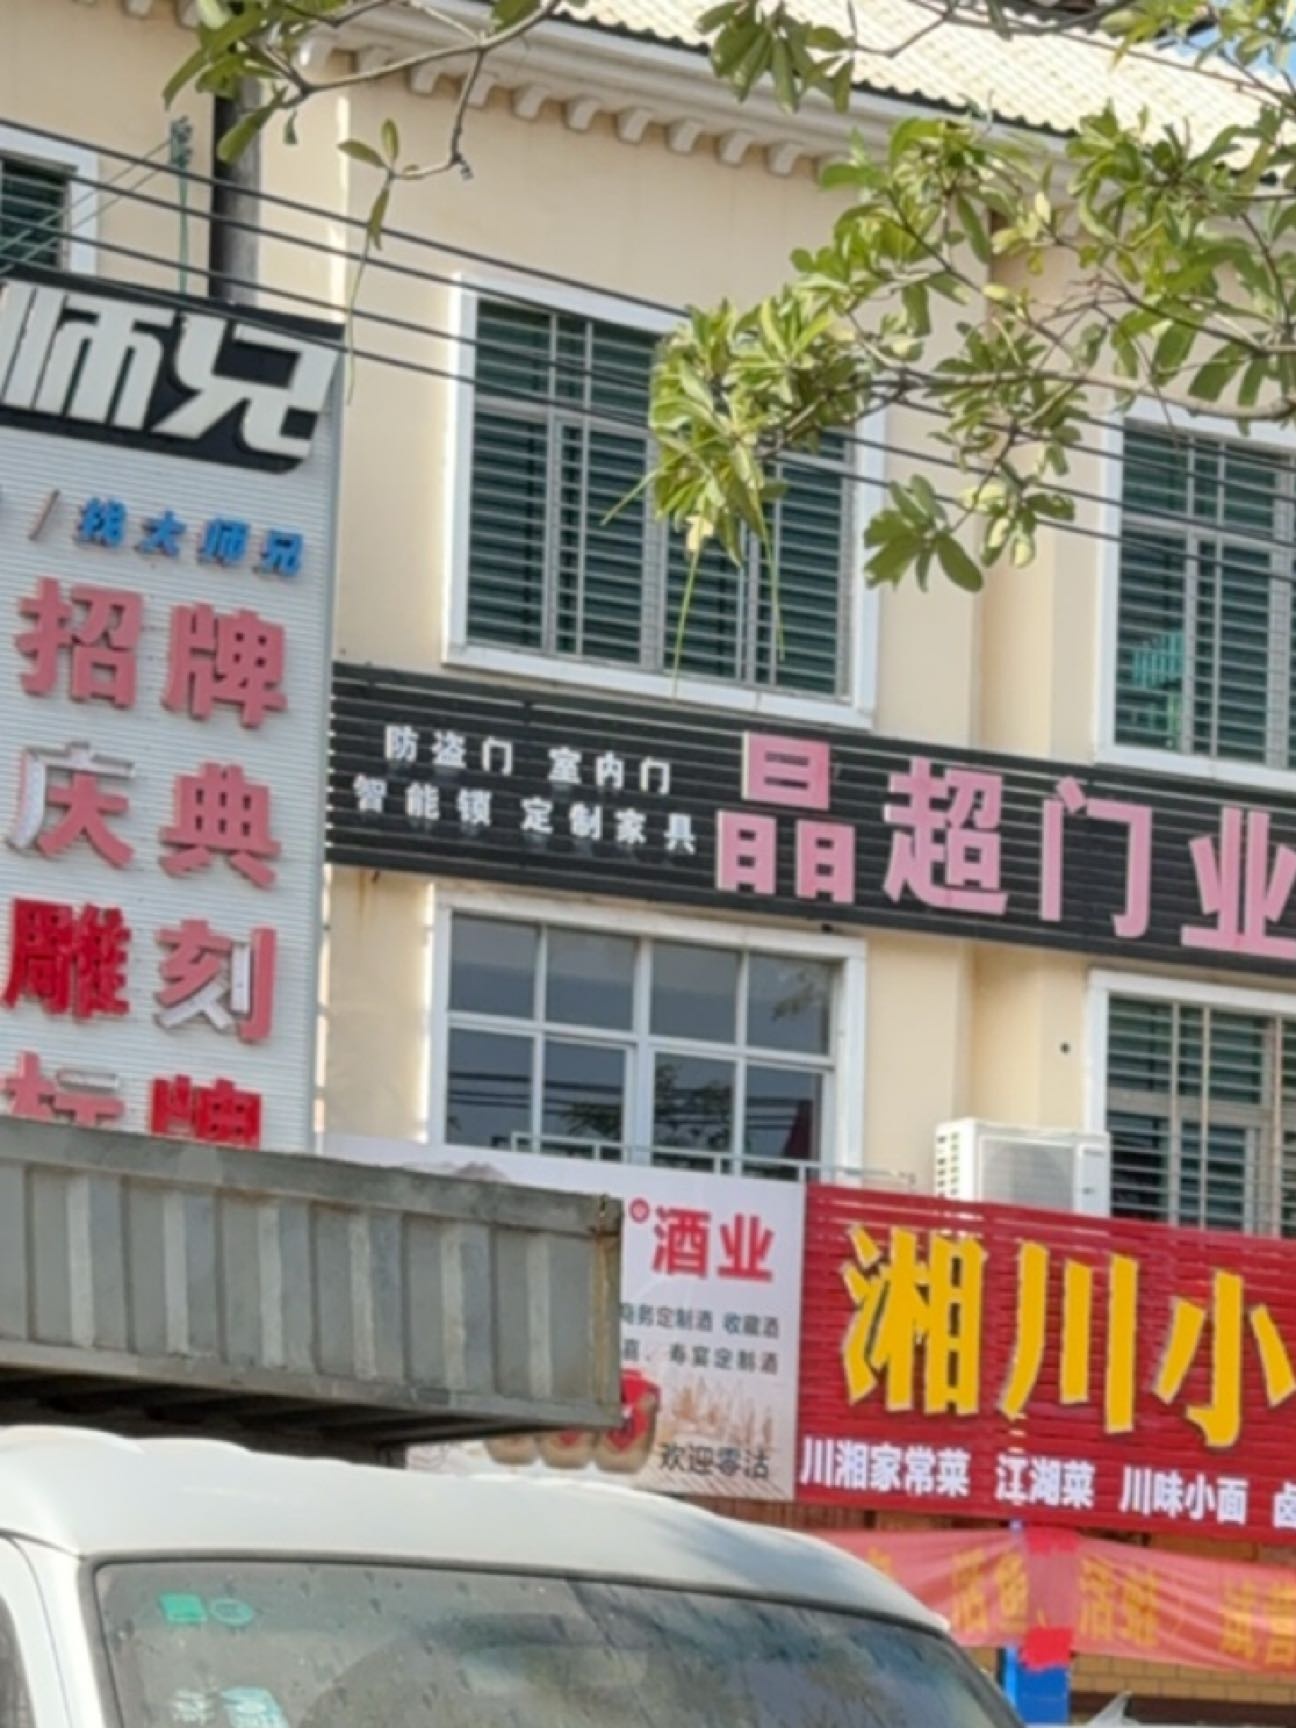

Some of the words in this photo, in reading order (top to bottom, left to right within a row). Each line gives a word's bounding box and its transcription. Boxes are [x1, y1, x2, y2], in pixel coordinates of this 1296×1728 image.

[14, 576, 288, 729] 招牌
[385, 724, 514, 777] 防盗门
[547, 746, 671, 795] 室内门
[8, 742, 281, 890] 庆典
[353, 773, 493, 828] 智能锁
[520, 796, 697, 856] 定制家具
[0, 898, 277, 1044] 雕刻
[652, 1204, 774, 1284] 酒业
[659, 1442, 771, 1480] 欢迎零沽
[799, 1436, 972, 1498] 川湘家常菜
[994, 1450, 1096, 1510] 江湖菜
[1118, 1463, 1249, 1526] 川味小面
